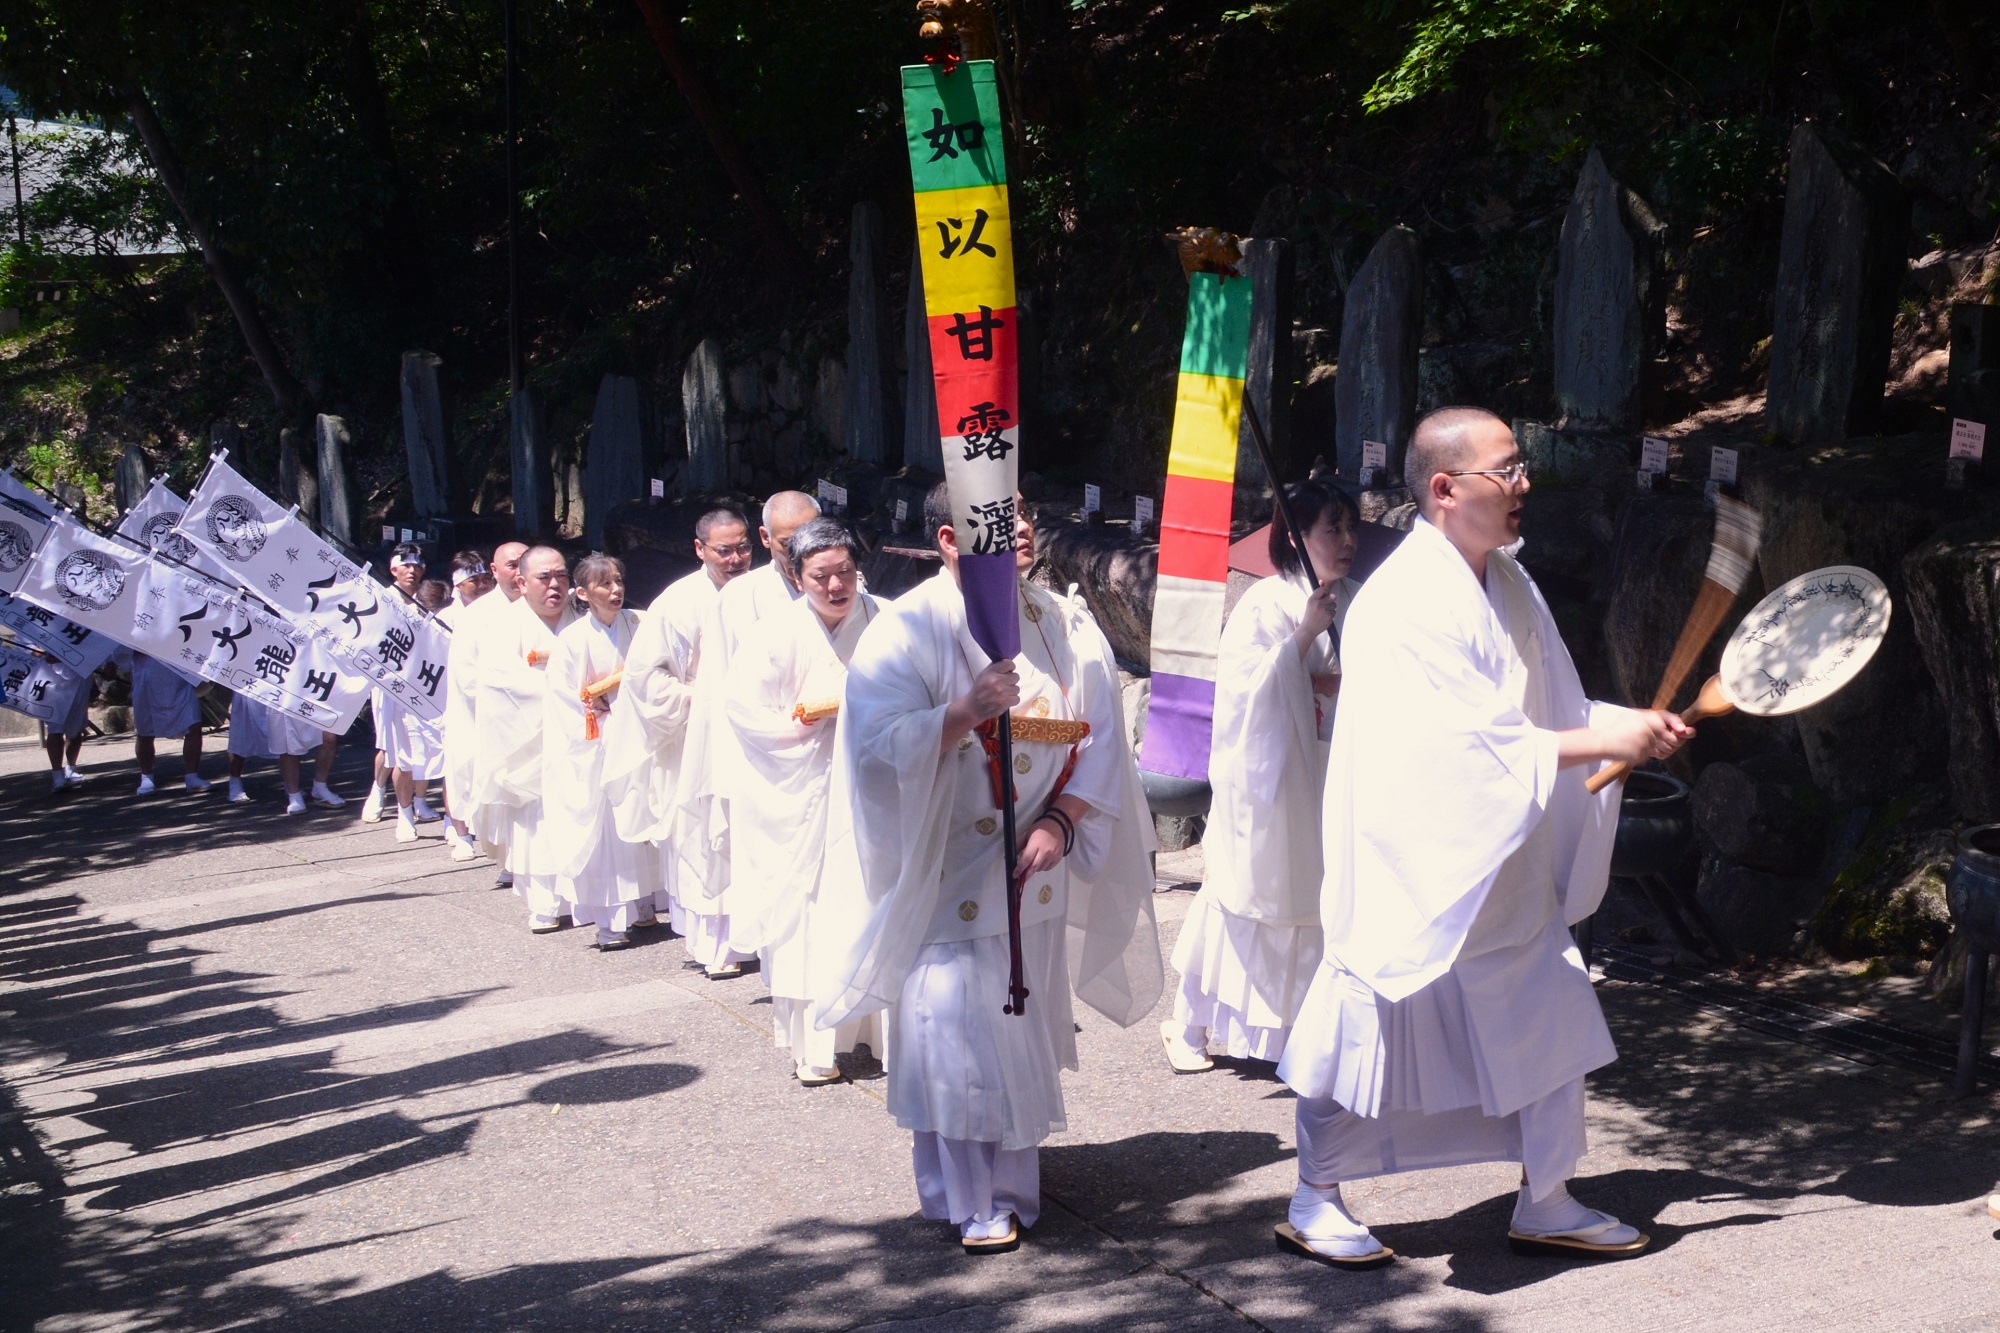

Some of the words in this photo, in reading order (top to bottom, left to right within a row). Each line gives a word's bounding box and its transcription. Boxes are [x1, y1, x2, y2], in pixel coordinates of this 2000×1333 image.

[922, 108, 1017, 556] 如以甘露灑
[0, 657, 51, 702] 龍王
[178, 602, 338, 702] 八大龍王
[306, 571, 446, 697] 八大龍王
